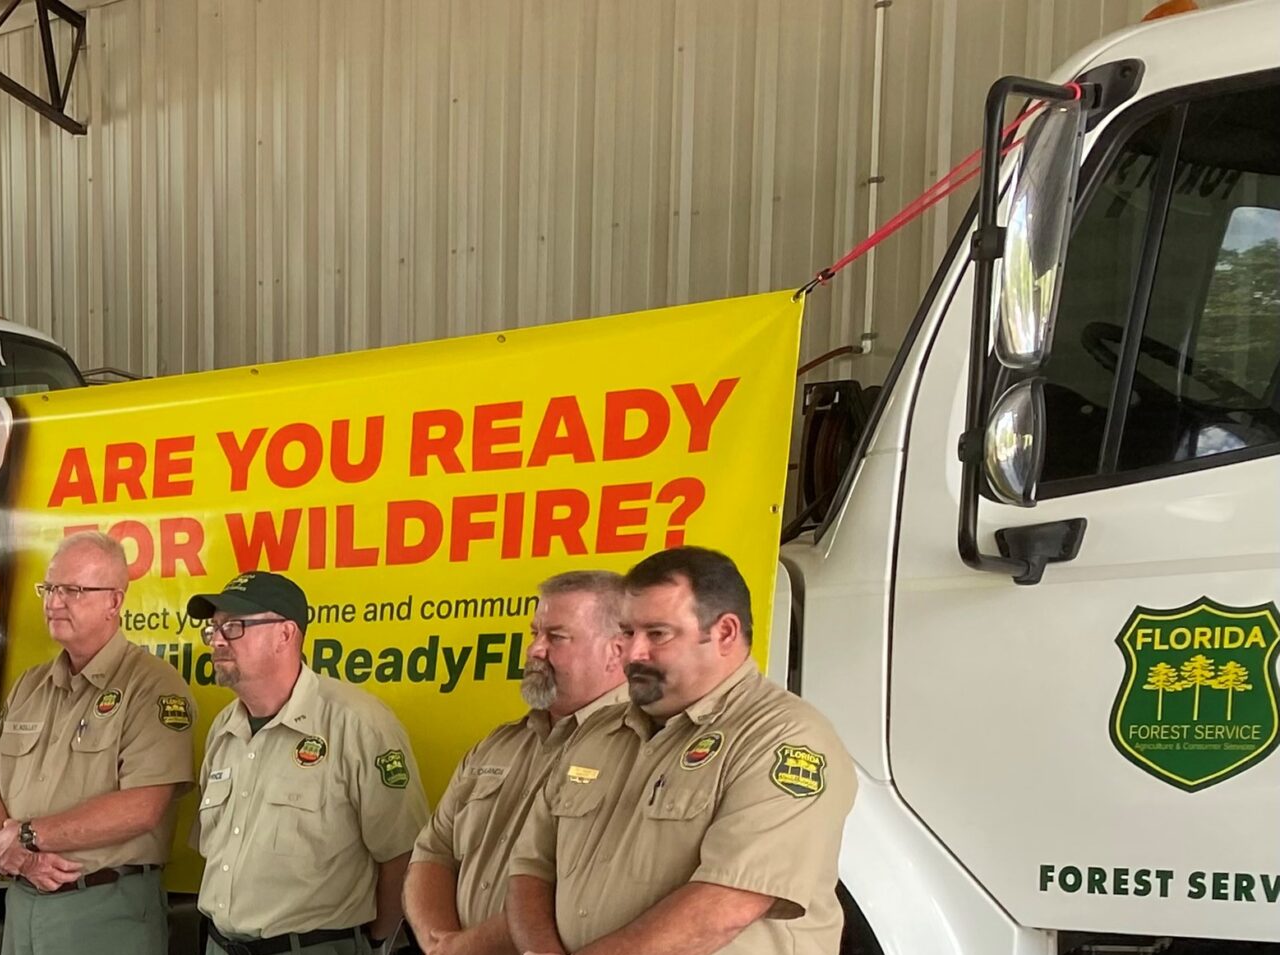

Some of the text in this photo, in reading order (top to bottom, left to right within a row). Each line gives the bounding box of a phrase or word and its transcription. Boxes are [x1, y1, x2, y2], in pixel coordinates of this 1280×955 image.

[47, 377, 740, 508] ARE YOU READY
[63, 476, 706, 582] OR WILDFIRE?
[119, 607, 170, 631] tect
[363, 594, 413, 622] and
[1135, 625, 1267, 651] FLORIDA
[1128, 724, 1263, 740] FOREST SERVICE
[784, 748, 821, 766] FLORIDA
[1039, 864, 1280, 903] FOREST SERV
